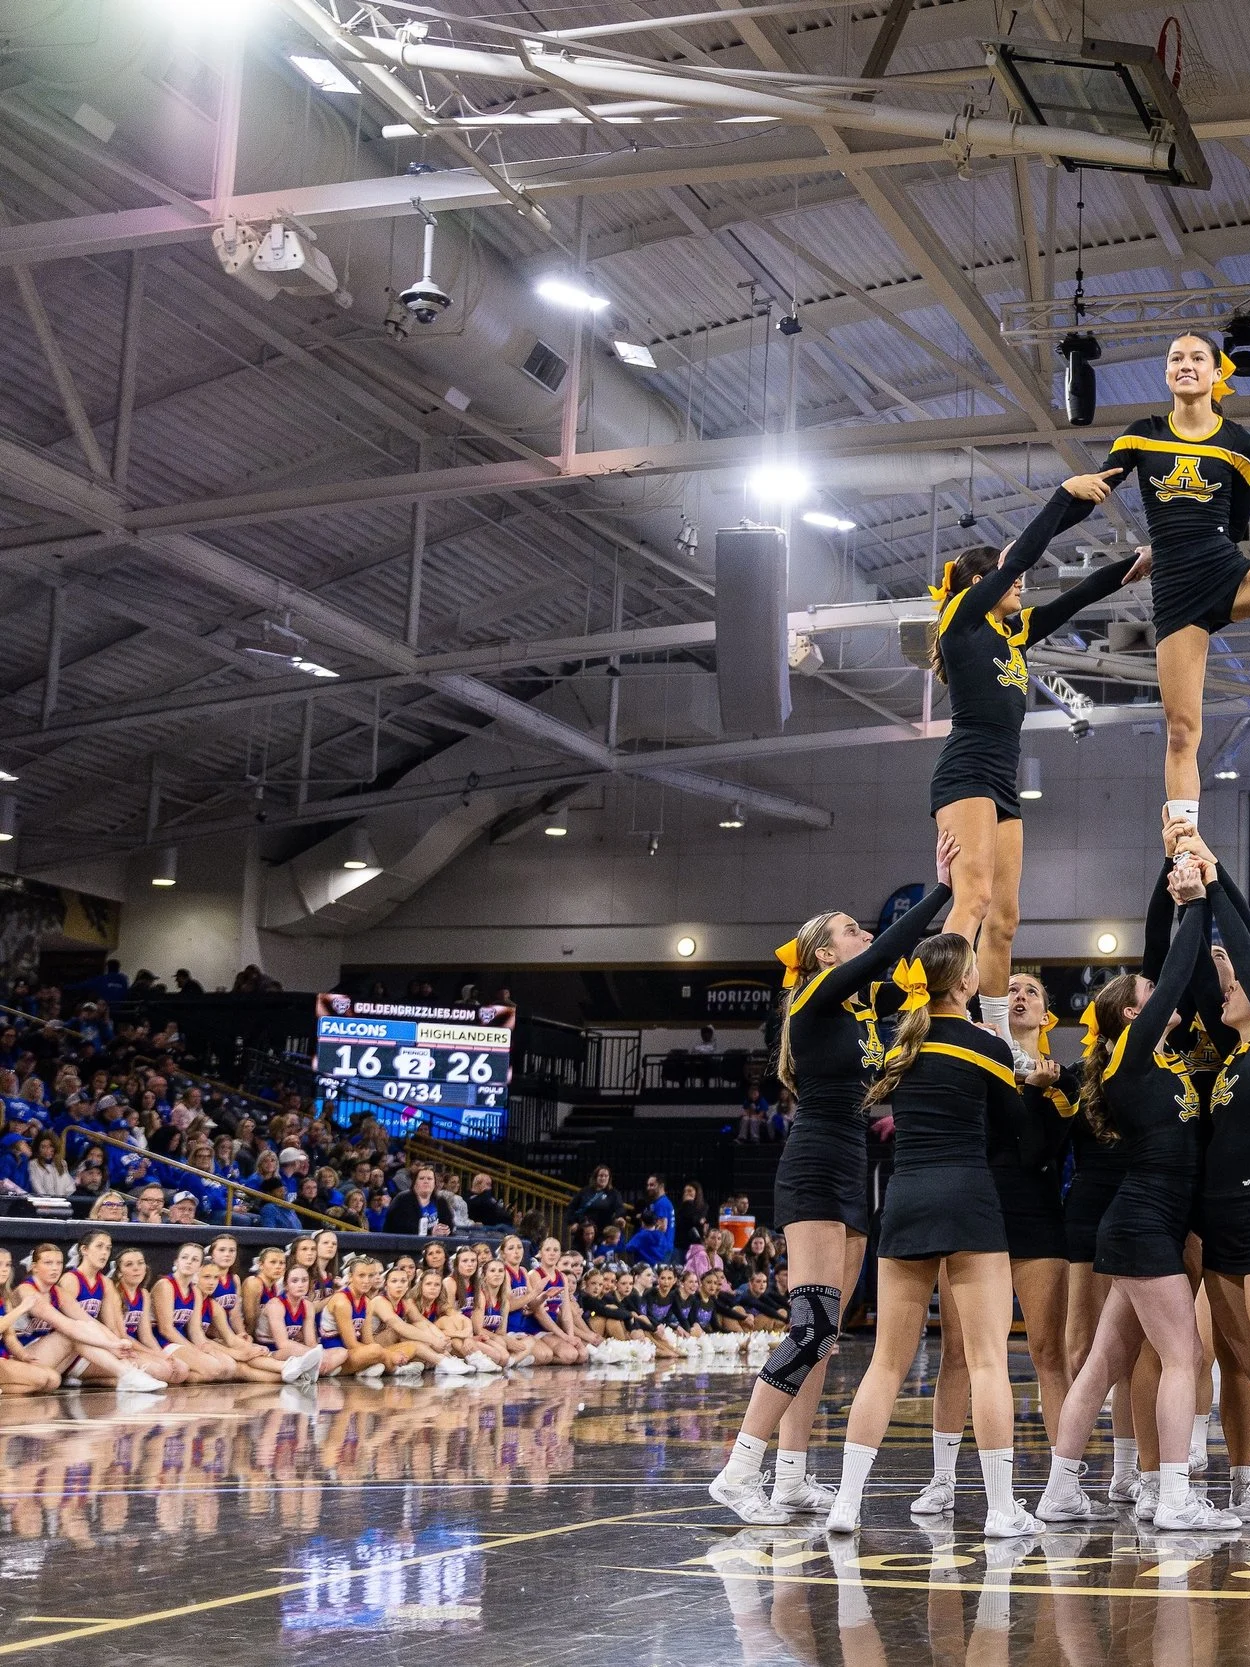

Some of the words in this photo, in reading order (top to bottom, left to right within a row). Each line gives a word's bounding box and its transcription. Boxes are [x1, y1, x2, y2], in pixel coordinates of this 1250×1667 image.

[1163, 456, 1208, 489] A
[707, 990, 772, 1003] HORIZON
[354, 1002, 476, 1020] GOLDENGRIZZLIES.COM
[321, 1021, 387, 1037] FALCONS
[420, 1028, 508, 1044] HIGHLANDERS
[332, 1045, 382, 1078] 16
[408, 1058, 421, 1075] 2
[446, 1051, 493, 1083] 26
[382, 1081, 442, 1103] 07:34
[485, 1093, 497, 1108] 4
